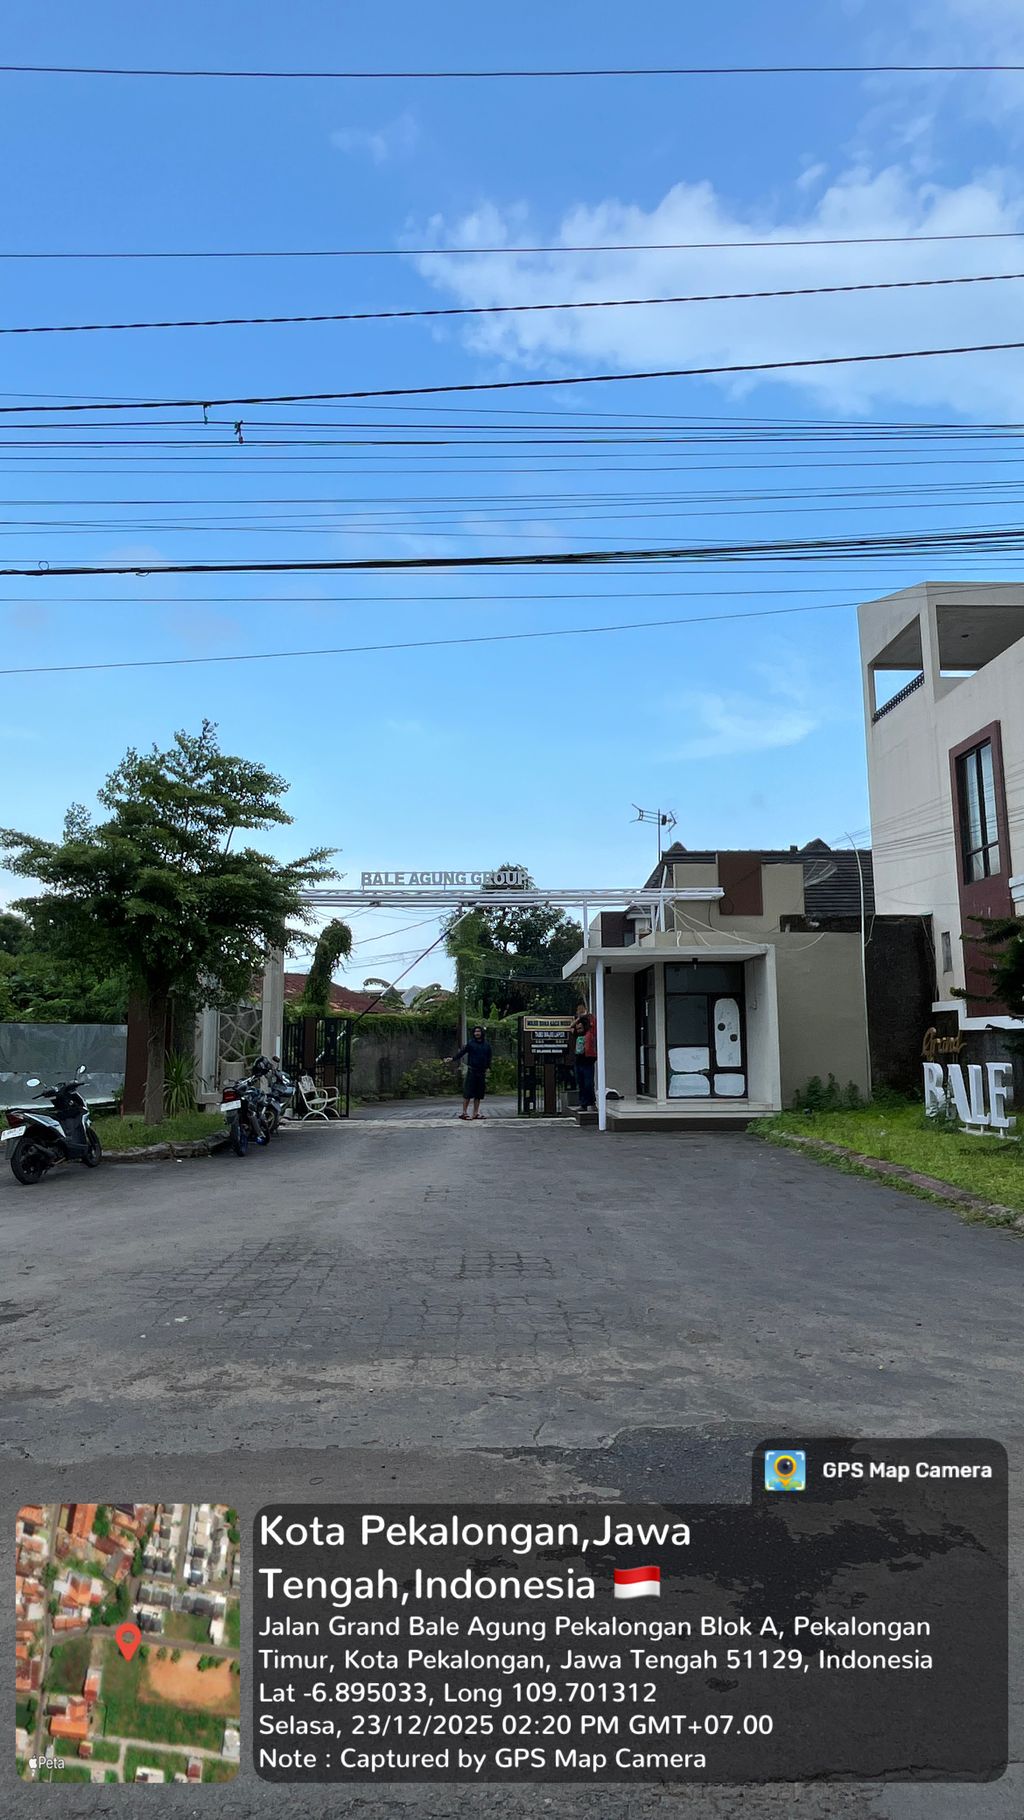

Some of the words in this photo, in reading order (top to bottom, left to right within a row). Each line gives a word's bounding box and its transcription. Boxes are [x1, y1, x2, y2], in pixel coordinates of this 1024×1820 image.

[361, 872, 405, 885] BALE
[409, 871, 467, 885] AGUNG
[471, 870, 527, 886] GROUP
[921, 1027, 967, 1061] Grand
[922, 1062, 1017, 1128] BALE
